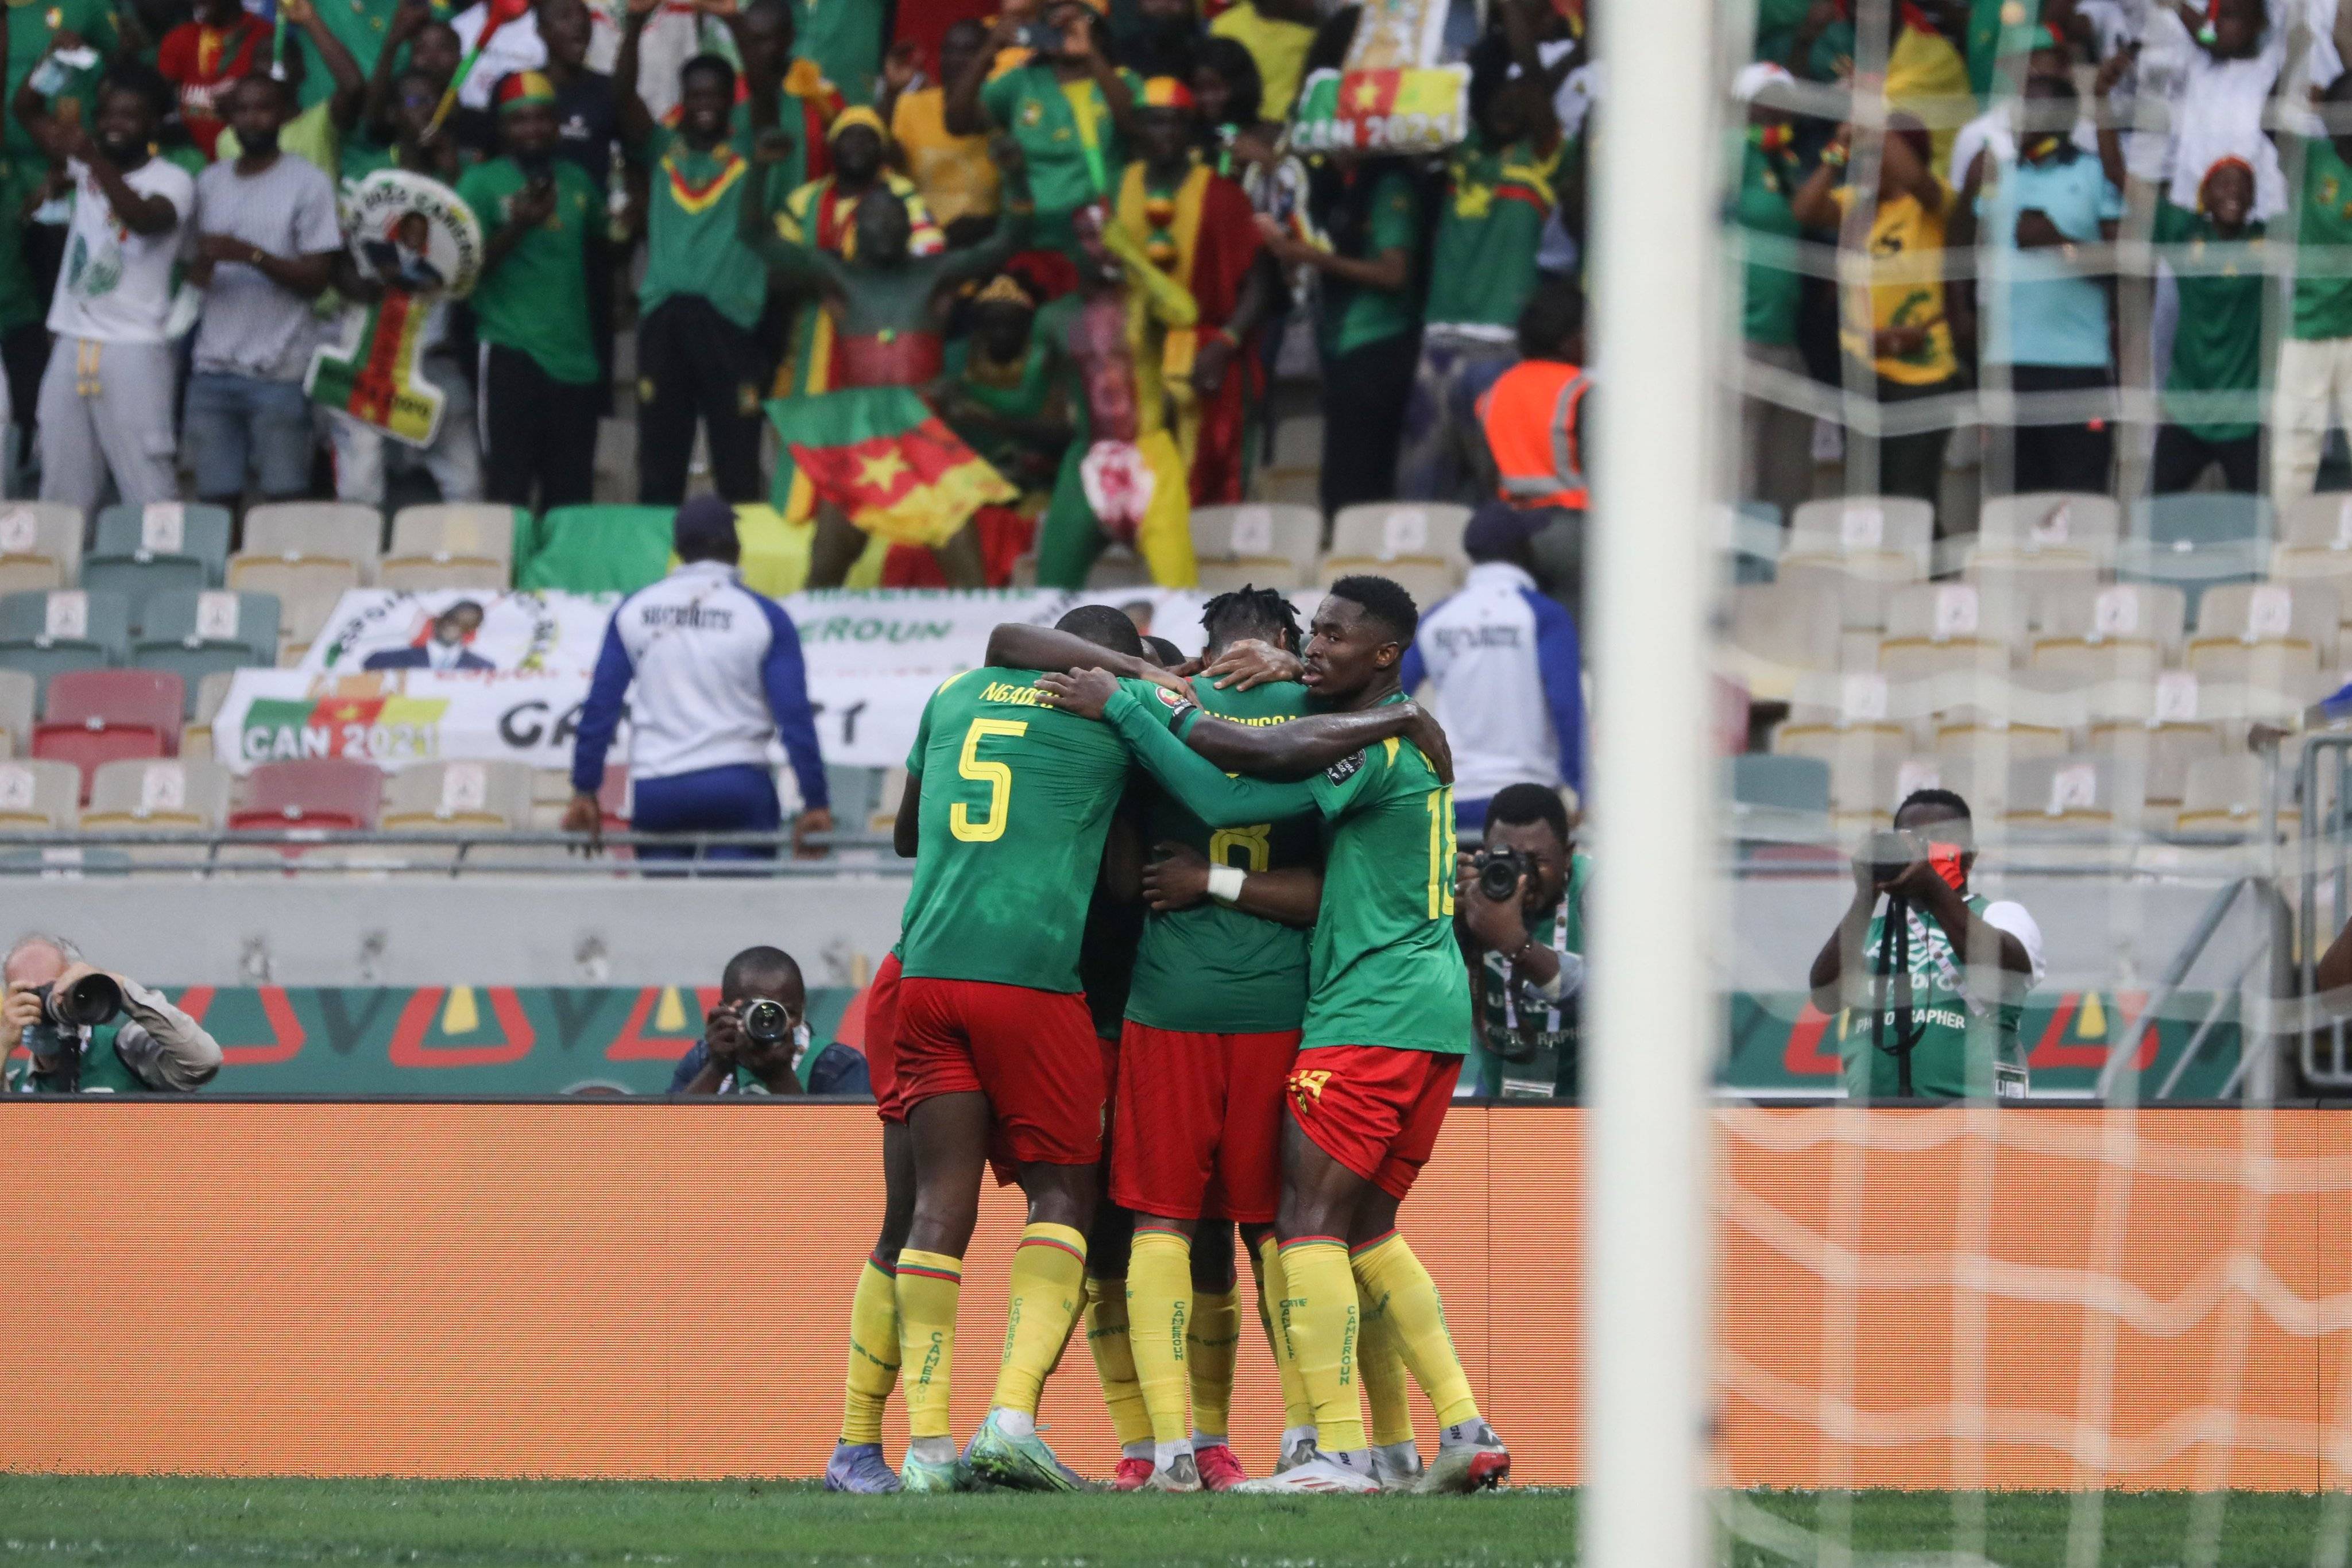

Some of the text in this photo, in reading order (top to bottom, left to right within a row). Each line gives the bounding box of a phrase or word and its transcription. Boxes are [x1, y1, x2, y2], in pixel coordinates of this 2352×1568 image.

[245, 722, 438, 760] CAN 2021
[950, 717, 1029, 842] 5
[1171, 1300, 1185, 1361] CAMEROUN
[1340, 1306, 1356, 1386] CAMEROUN
